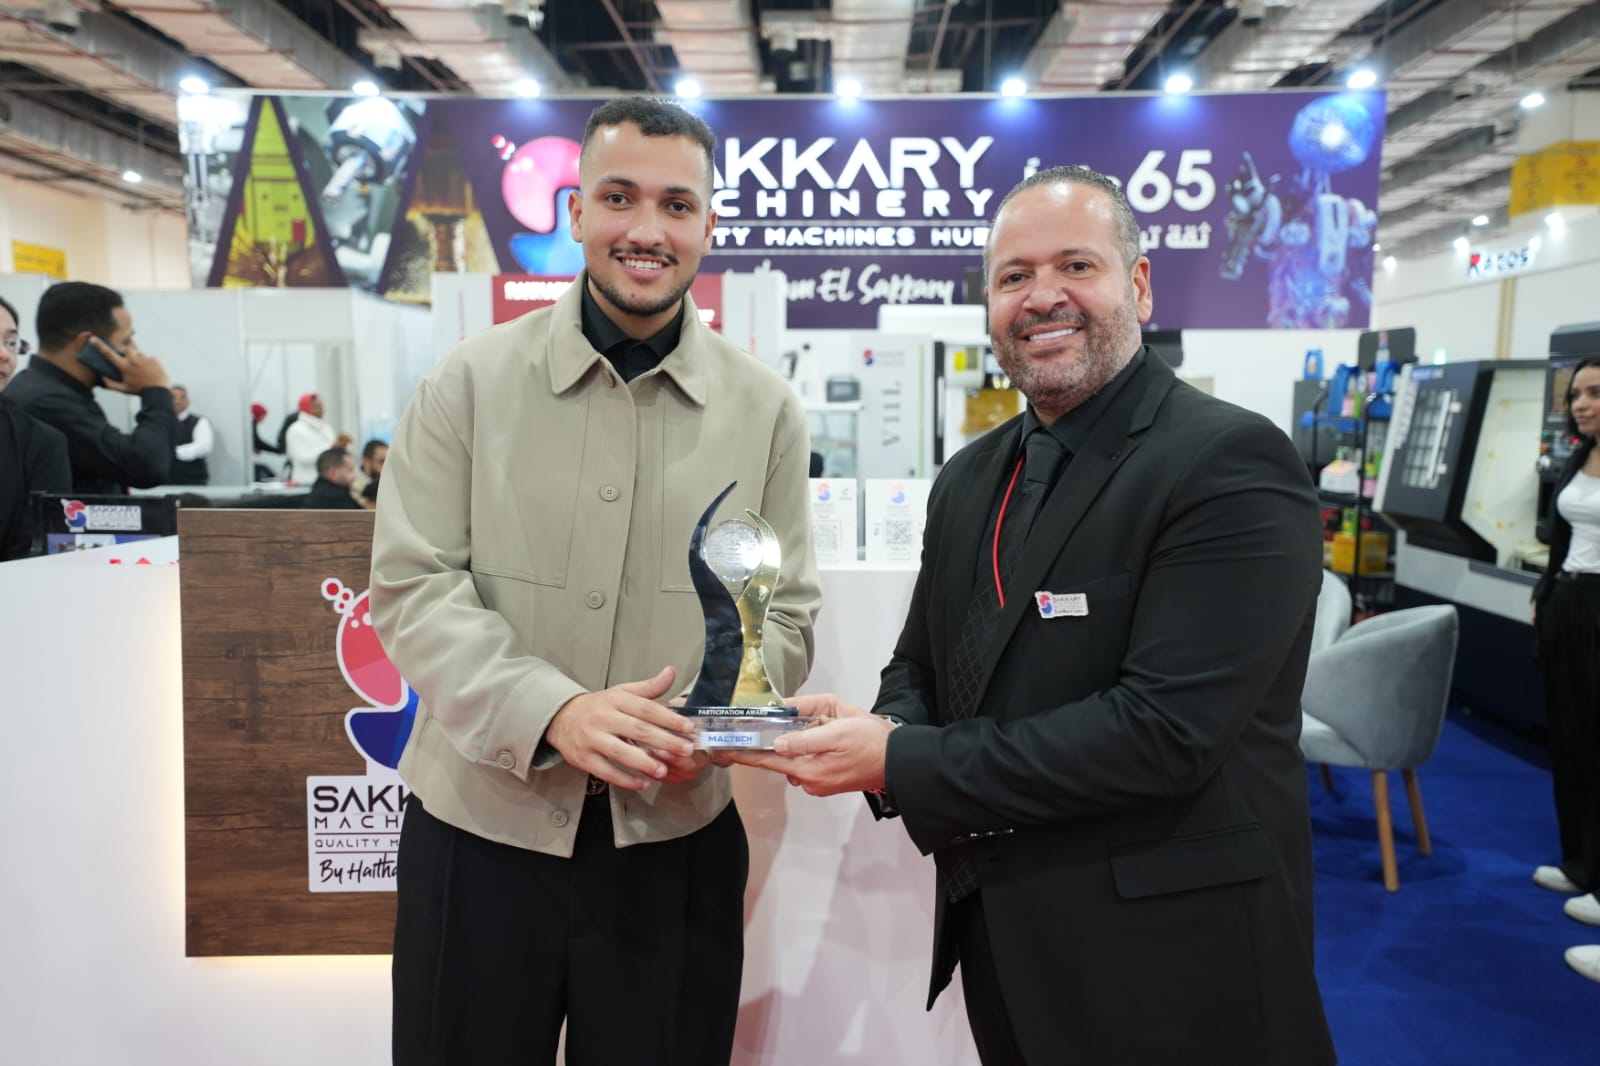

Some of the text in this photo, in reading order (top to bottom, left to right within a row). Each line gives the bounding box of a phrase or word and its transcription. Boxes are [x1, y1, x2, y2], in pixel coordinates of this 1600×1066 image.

[713, 137, 995, 189] KKARY
[1126, 149, 1216, 212] 65
[711, 189, 994, 217] CHINERY
[764, 226, 916, 247] MACHINES
[313, 785, 409, 813] SAKK
[314, 839, 380, 848] QUALITY
[319, 852, 399, 884] By Haitha
